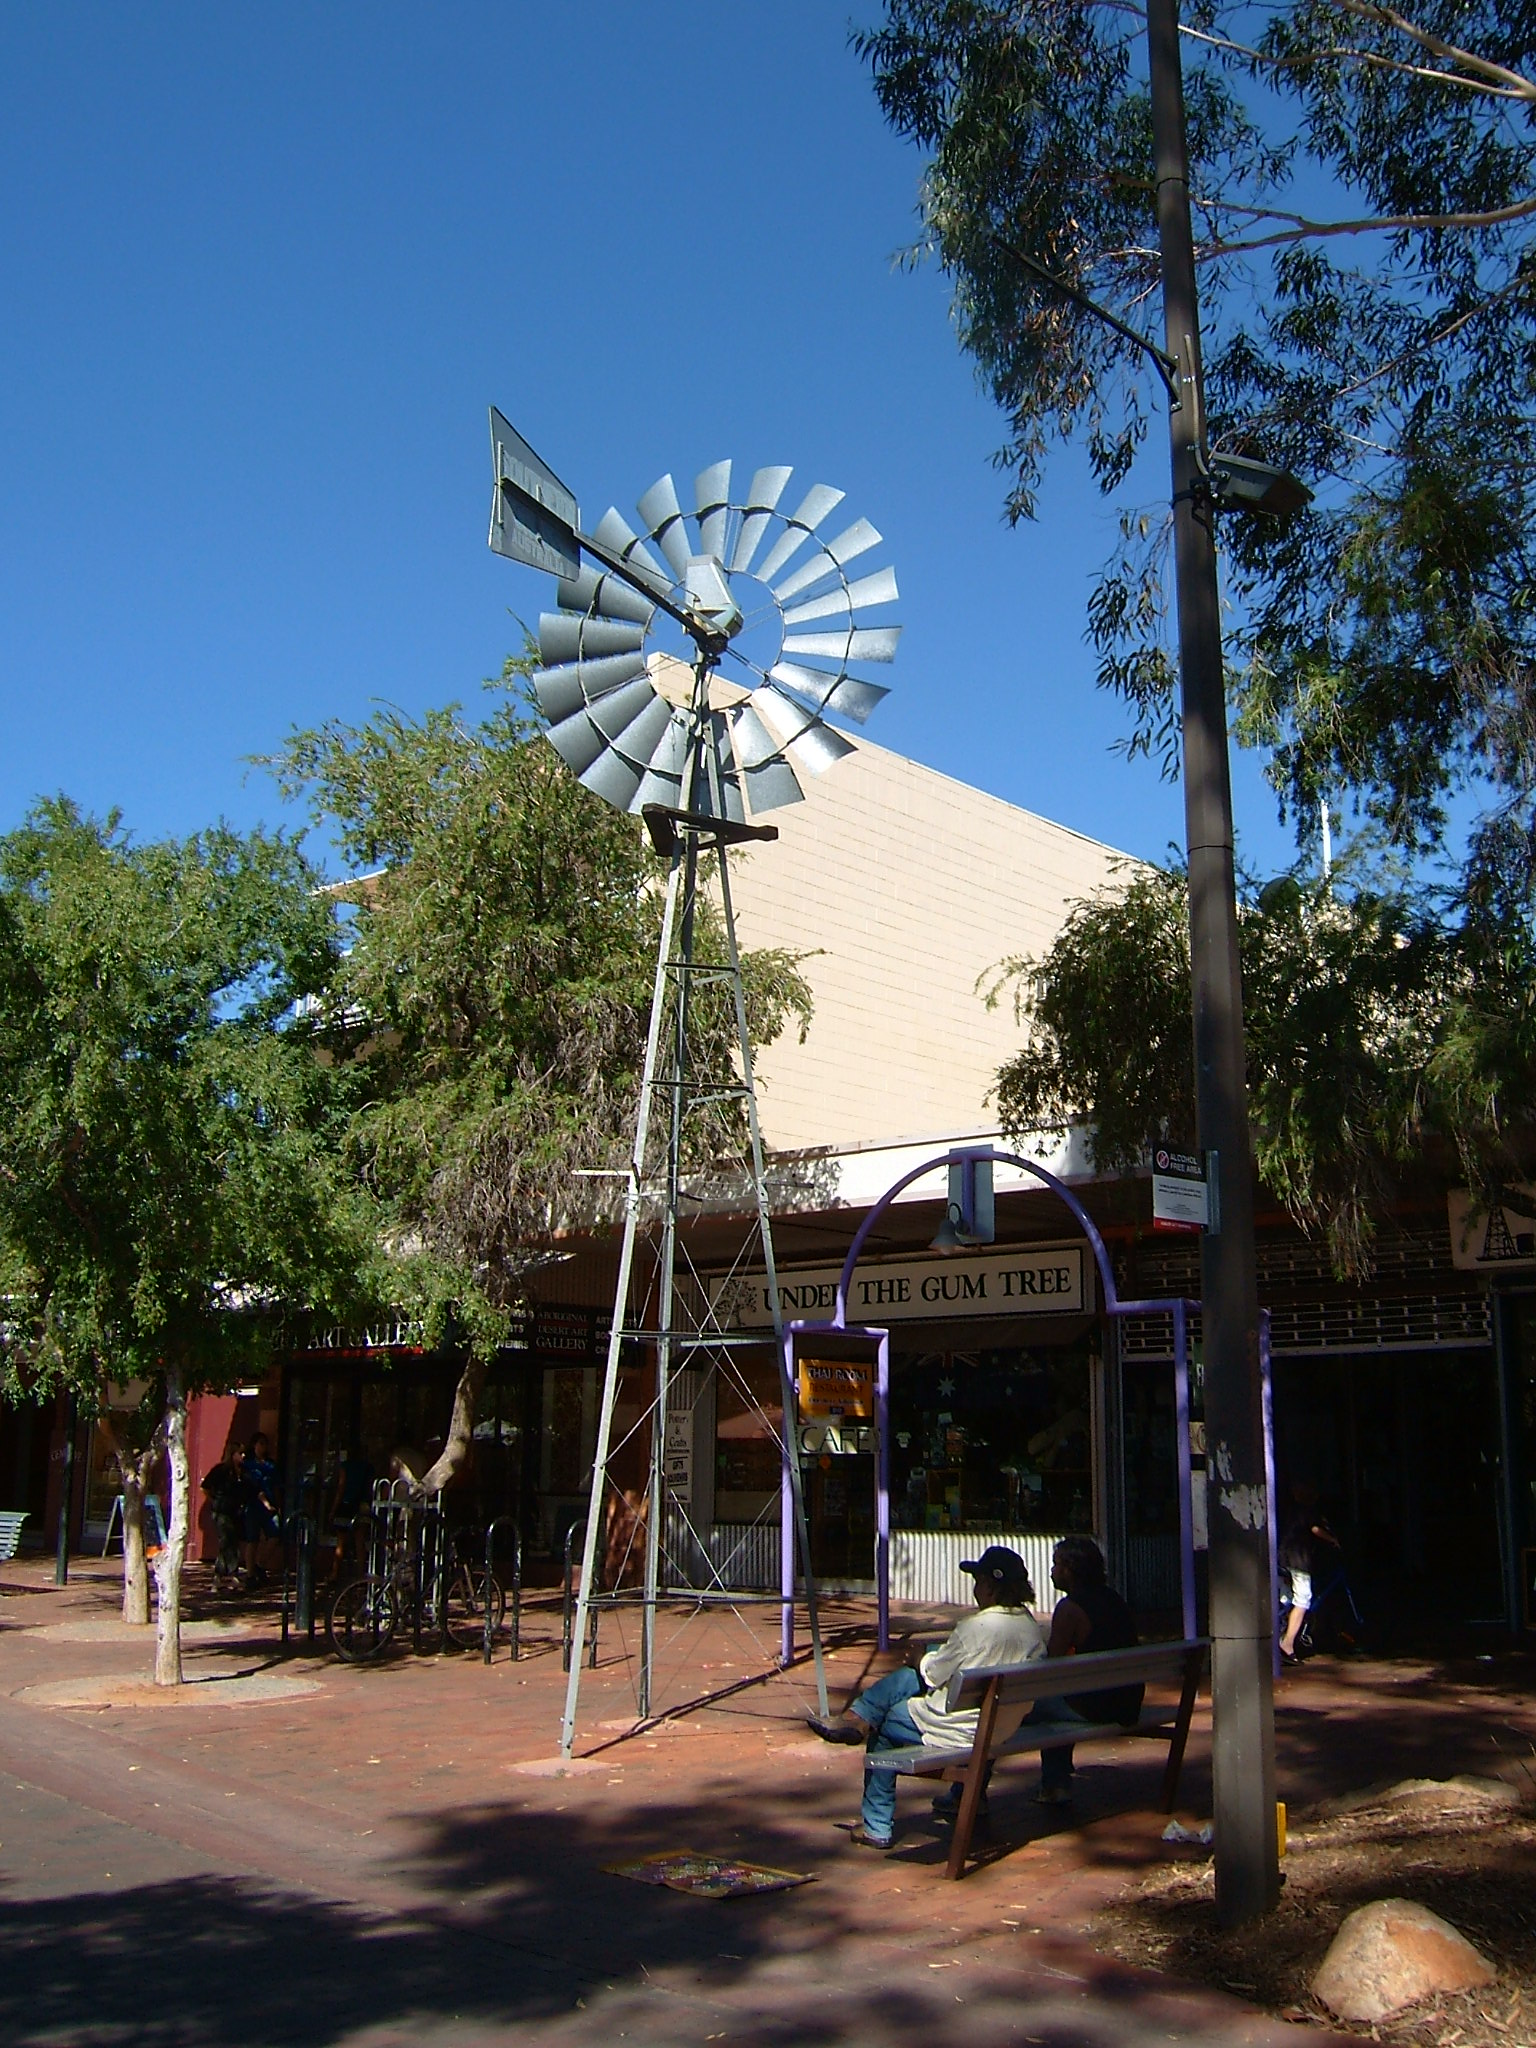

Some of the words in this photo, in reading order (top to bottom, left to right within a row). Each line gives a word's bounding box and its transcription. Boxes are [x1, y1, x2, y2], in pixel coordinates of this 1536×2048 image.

[1170, 1153, 1198, 1165] ALCOHOL
[1170, 1162, 1185, 1174] FREE
[1186, 1165, 1202, 1176] AREA
[763, 1282, 846, 1311] UNDE
[857, 1277, 912, 1305] THE
[921, 1273, 988, 1302] GUM
[998, 1267, 1072, 1297] TREE
[536, 1311, 588, 1322] ABORIGINAL
[306, 1325, 344, 1350] ART
[348, 1320, 423, 1348] GALLE
[537, 1324, 569, 1336] DESERT
[571, 1327, 589, 1337] ART
[535, 1336, 588, 1350] GALLERY
[808, 1366, 832, 1380] THAI
[835, 1368, 868, 1382] ROOM
[800, 1424, 871, 1453] CAFE
